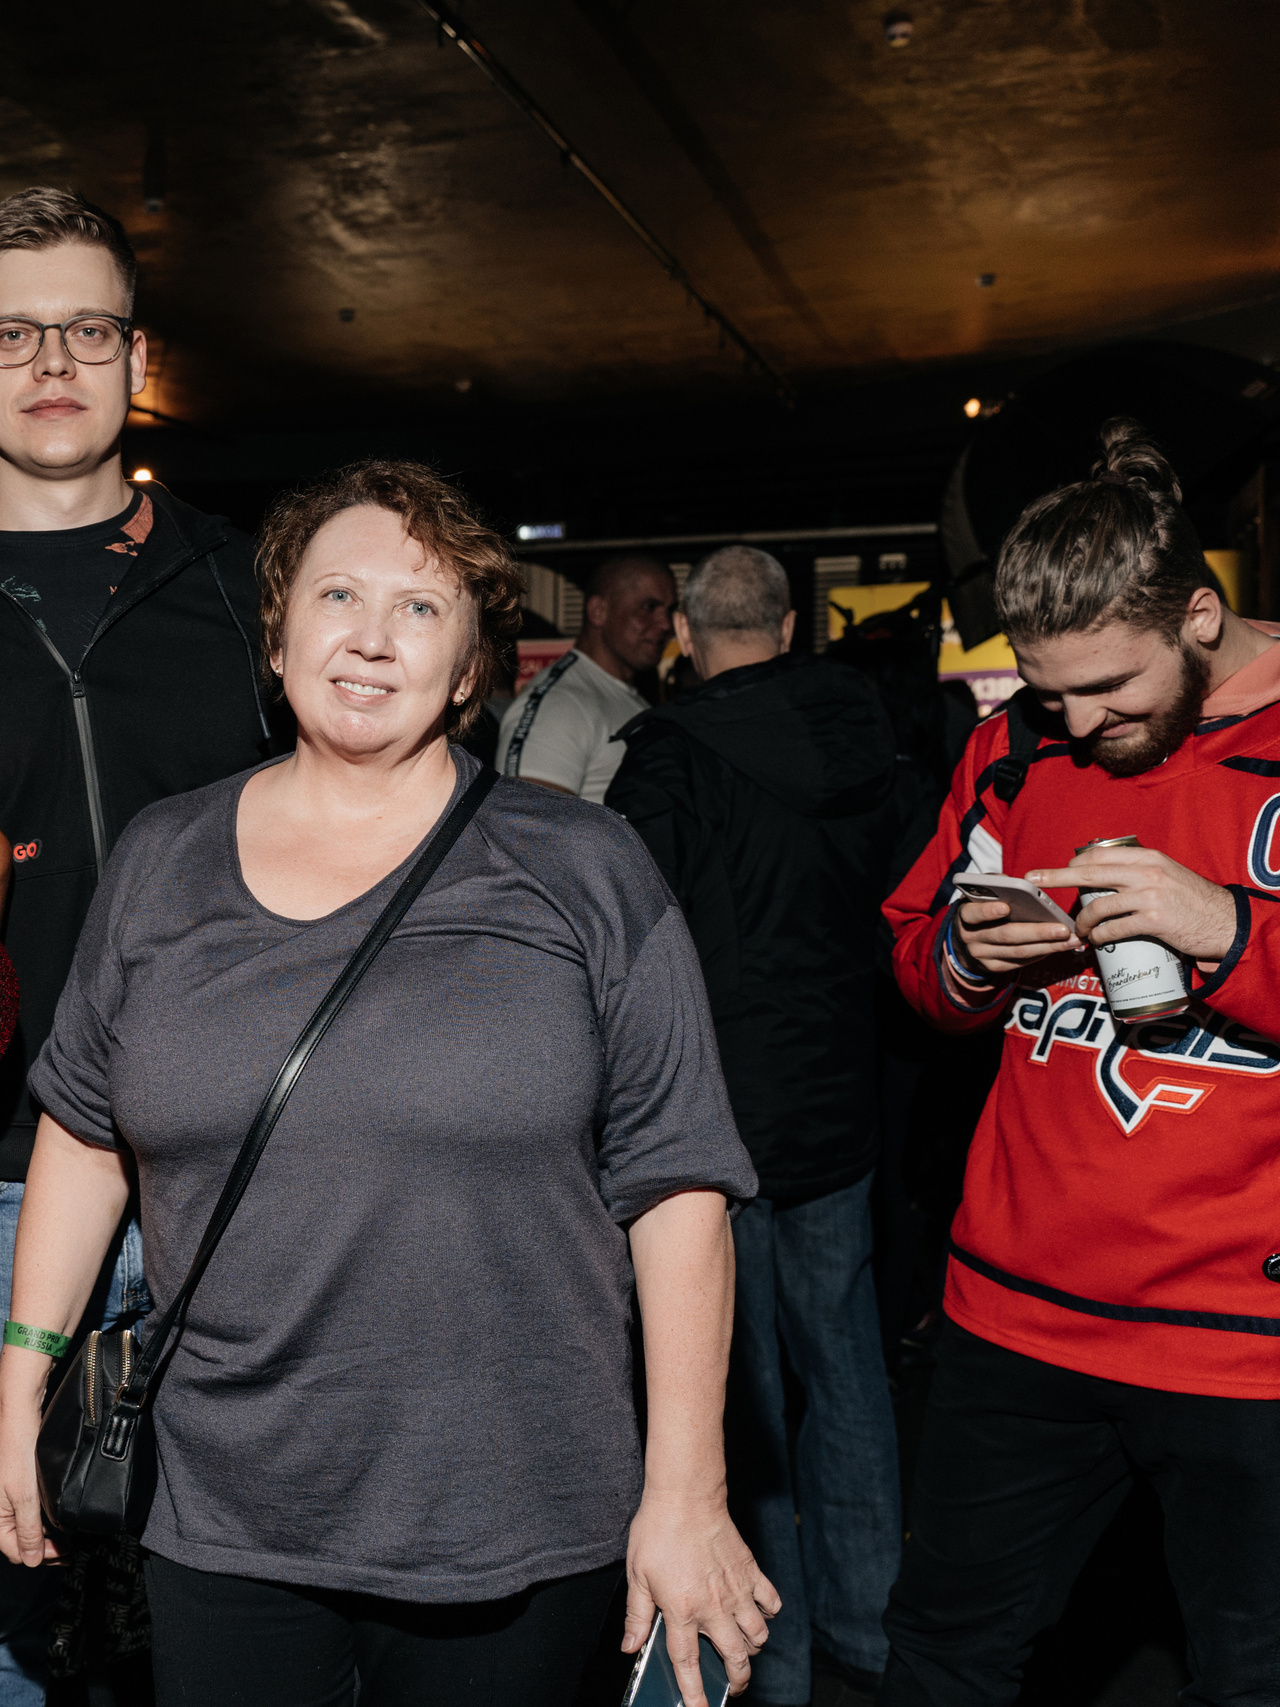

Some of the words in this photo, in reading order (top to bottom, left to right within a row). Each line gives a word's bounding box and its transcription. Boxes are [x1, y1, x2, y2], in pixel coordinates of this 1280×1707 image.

[13, 842, 38, 860] GO
[1106, 965, 1161, 992] Brandenburg
[17, 1326, 46, 1340] GRAND
[23, 1337, 53, 1352] RUSSIA
